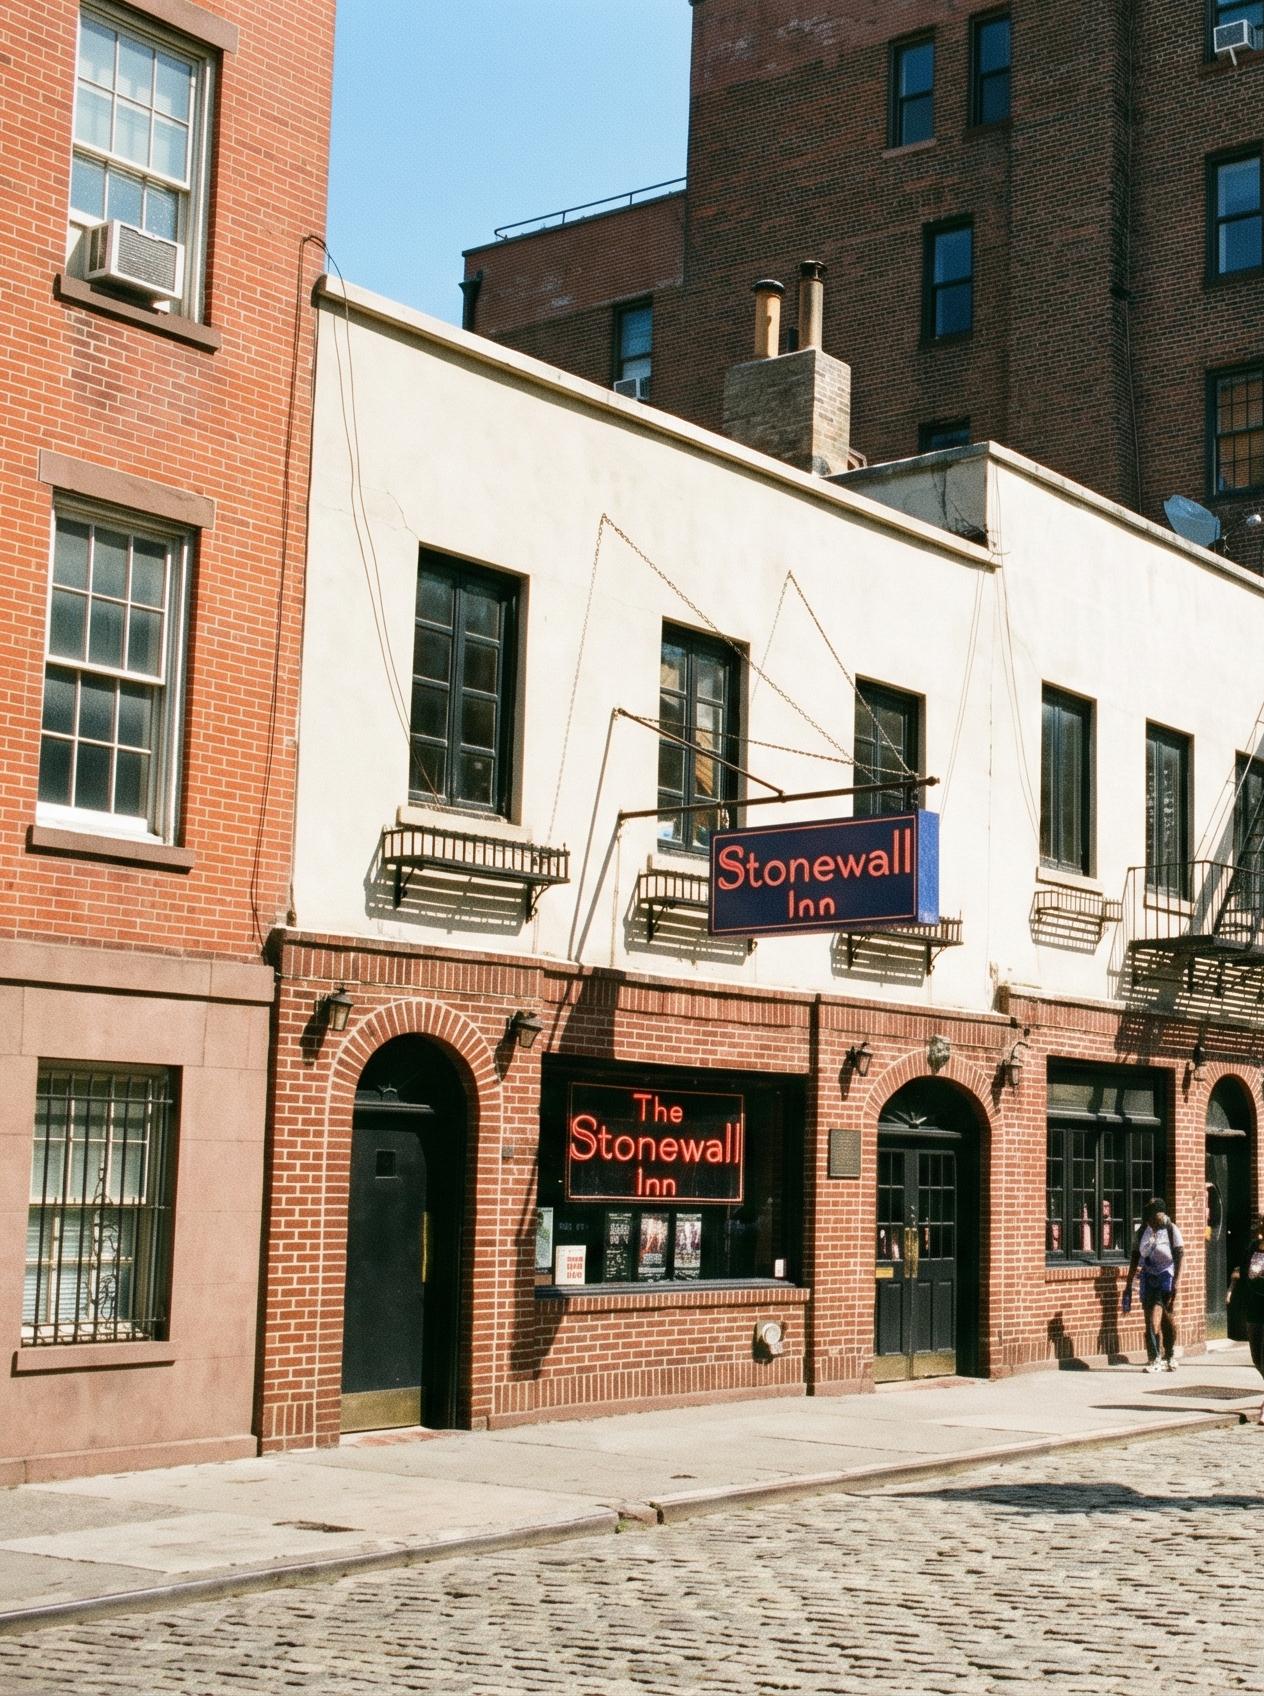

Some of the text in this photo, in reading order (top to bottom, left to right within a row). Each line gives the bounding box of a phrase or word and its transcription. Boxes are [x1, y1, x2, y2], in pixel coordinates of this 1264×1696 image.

[718, 828, 911, 890] Stonewall
[788, 889, 836, 919] Inn
[633, 1093, 683, 1123] The
[570, 1114, 740, 1164] Stonewall
[636, 1166, 677, 1196] Inn
